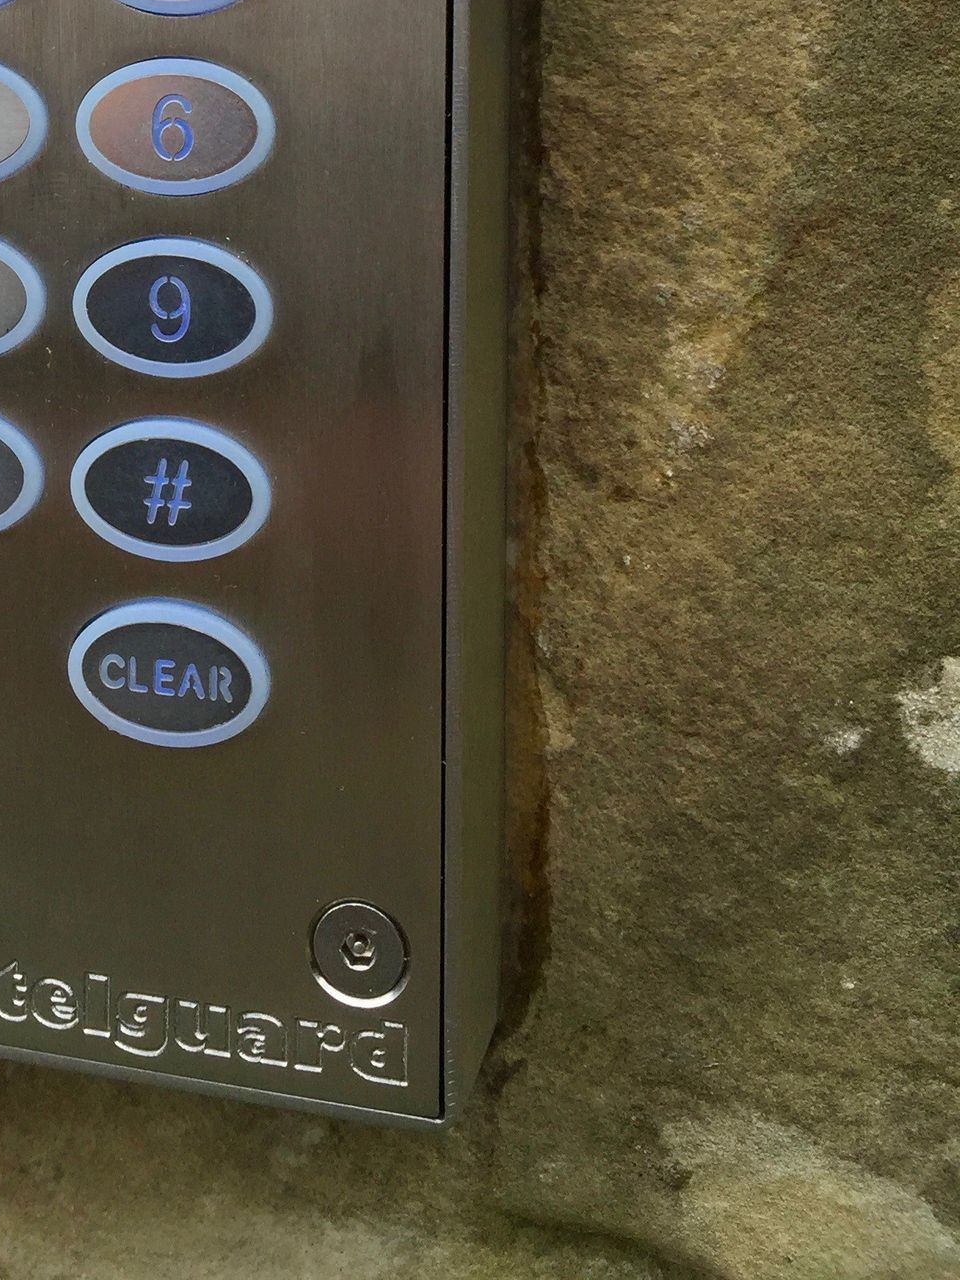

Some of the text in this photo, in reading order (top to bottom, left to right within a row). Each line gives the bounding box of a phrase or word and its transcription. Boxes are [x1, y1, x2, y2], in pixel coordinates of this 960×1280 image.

[151, 94, 194, 162] 6
[148, 275, 191, 343] 9
[143, 457, 192, 526] #
[98, 653, 233, 703] CLEAR
